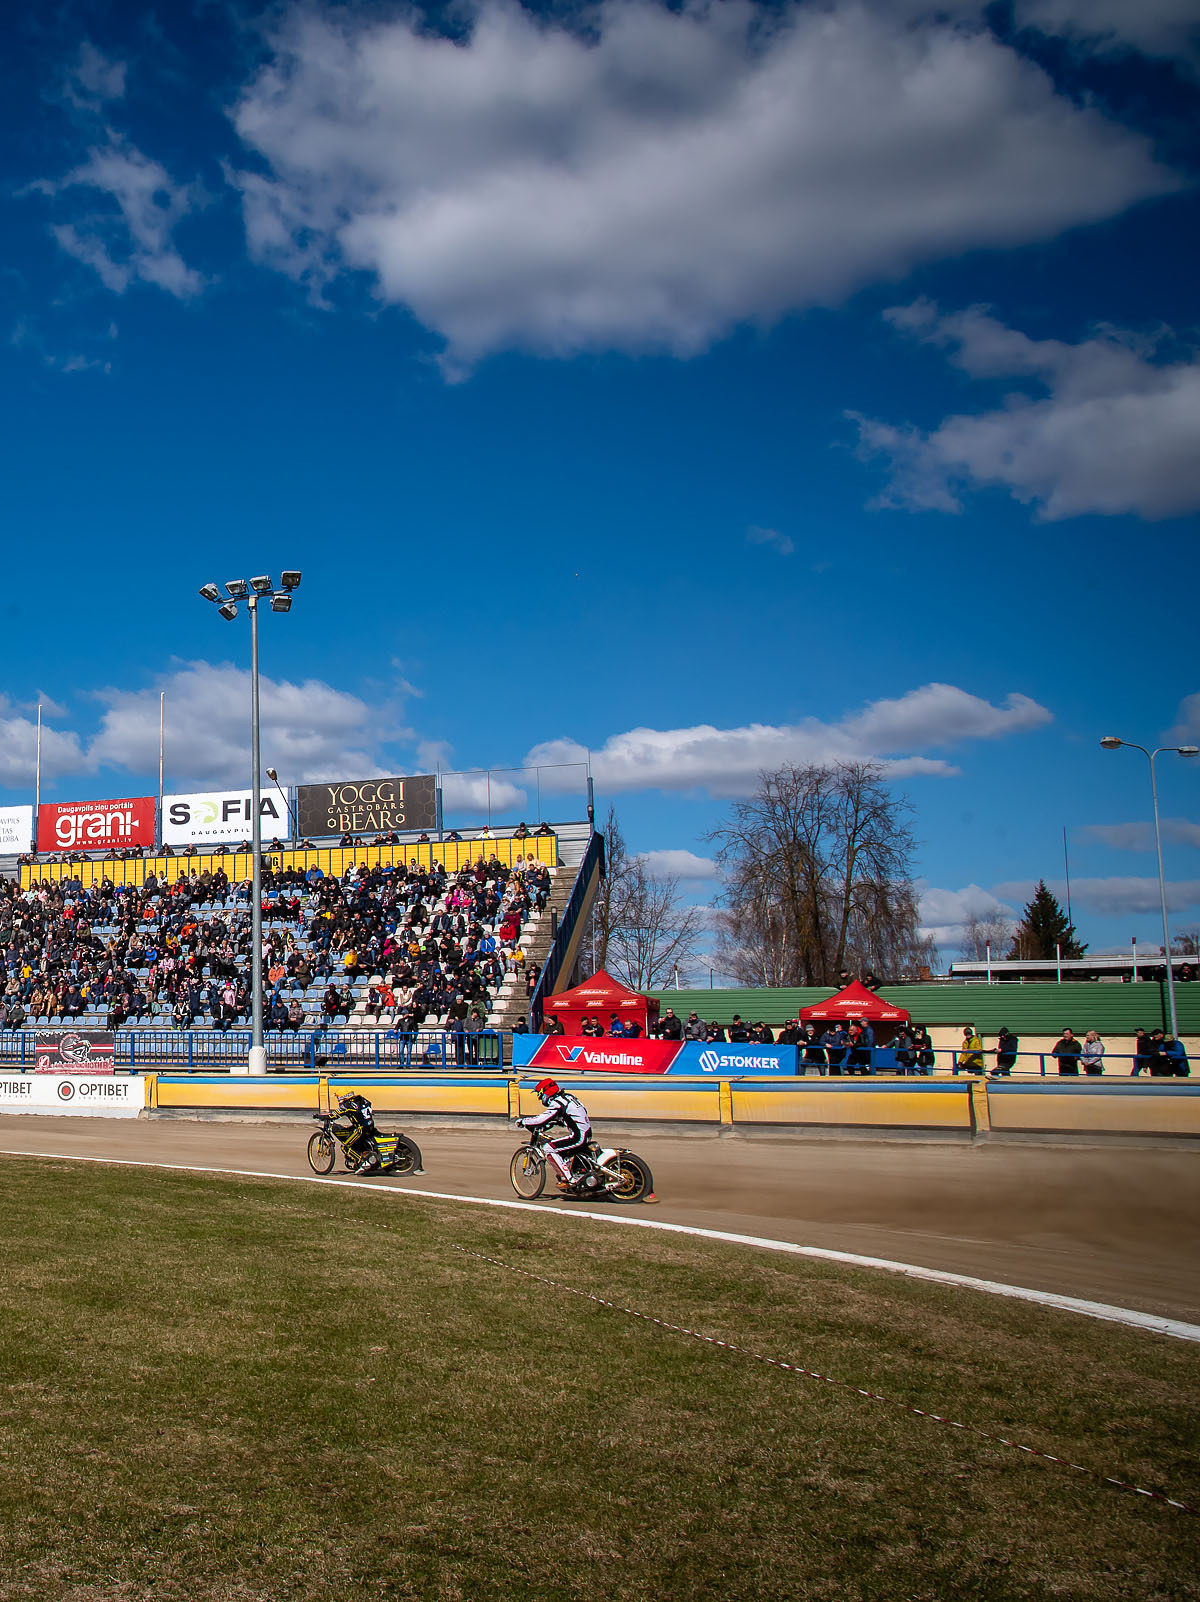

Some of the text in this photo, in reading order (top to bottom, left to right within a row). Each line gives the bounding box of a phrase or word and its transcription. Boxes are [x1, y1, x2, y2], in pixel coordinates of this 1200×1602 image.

[327, 781, 404, 806] YOGGI
[57, 805, 94, 814] Daugavpils
[338, 810, 396, 832] BEAR
[56, 811, 132, 848] grani
[191, 828, 250, 836] DAUGAVPIL
[583, 1051, 644, 1066] Valvoline
[720, 1055, 780, 1069] STOKKER
[79, 1083, 128, 1096] OPTIBET
